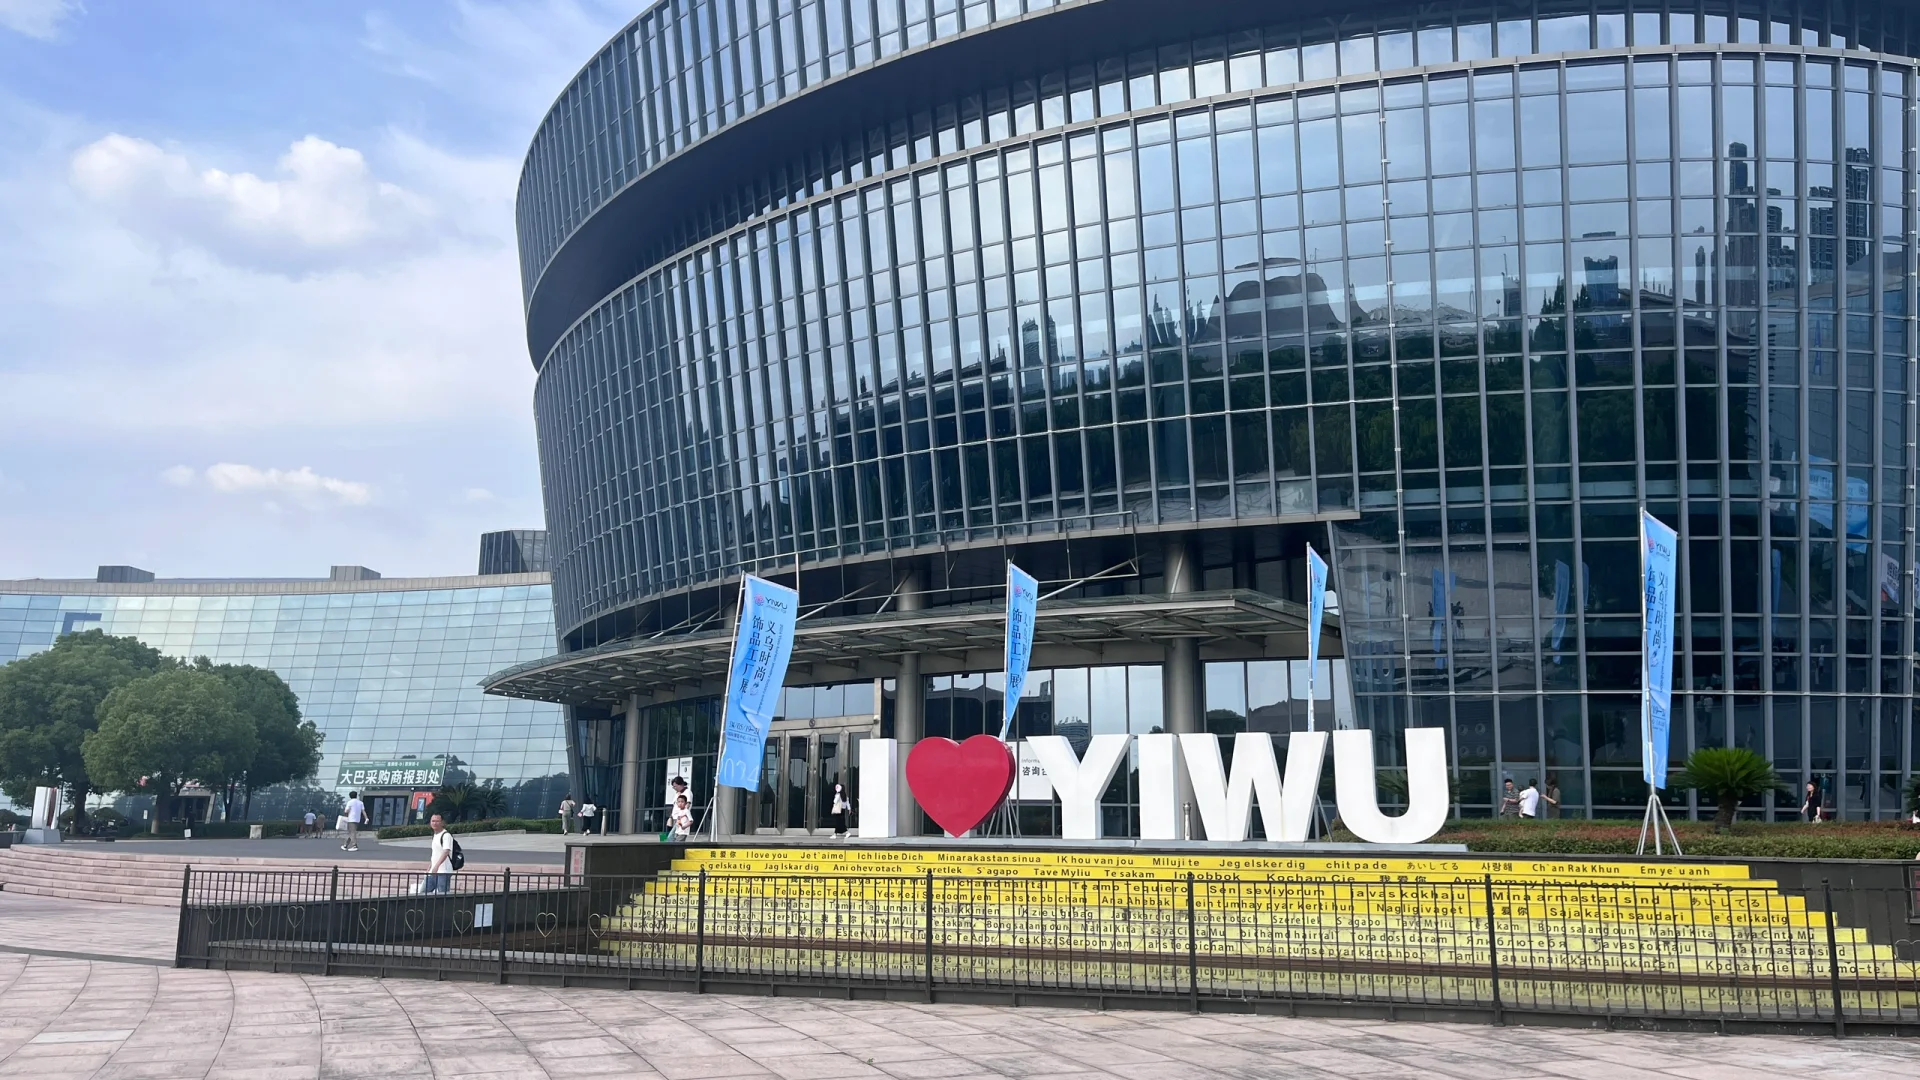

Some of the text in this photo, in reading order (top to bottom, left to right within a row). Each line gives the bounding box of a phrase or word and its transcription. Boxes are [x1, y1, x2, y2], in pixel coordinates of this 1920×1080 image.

[765, 596, 788, 610] YIWU
[754, 619, 776, 682] 义乌时尚
[1010, 607, 1022, 688] 饰品工厂展
[740, 615, 764, 693] 饰品工厂展
[340, 769, 440, 784] 大巴采购商报到处
[858, 727, 1450, 844] I YIWU
[938, 854, 1041, 863] Minarakastan sinua
[1116, 858, 1133, 866] jou
[1153, 858, 1185, 868] Miluji
[805, 863, 819, 872] dig
[1220, 860, 1305, 870] Jeg elsker dig
[1326, 861, 1350, 869] chit
[1355, 862, 1368, 870] pa
[1407, 862, 1459, 870] あいしてる
[1482, 863, 1512, 872] 사랑해
[1568, 865, 1587, 873] Rak
[1591, 865, 1619, 873] Khun
[1267, 873, 1326, 882] Kocham
[1210, 886, 1236, 894] Sen
[1692, 897, 1760, 908] あいしてる
[1486, 907, 1528, 916] 爱你
[1484, 922, 1519, 930] skam
[1178, 927, 1206, 935] Cita
[1762, 930, 1793, 939] Cnta
[1818, 947, 1845, 956] sid
